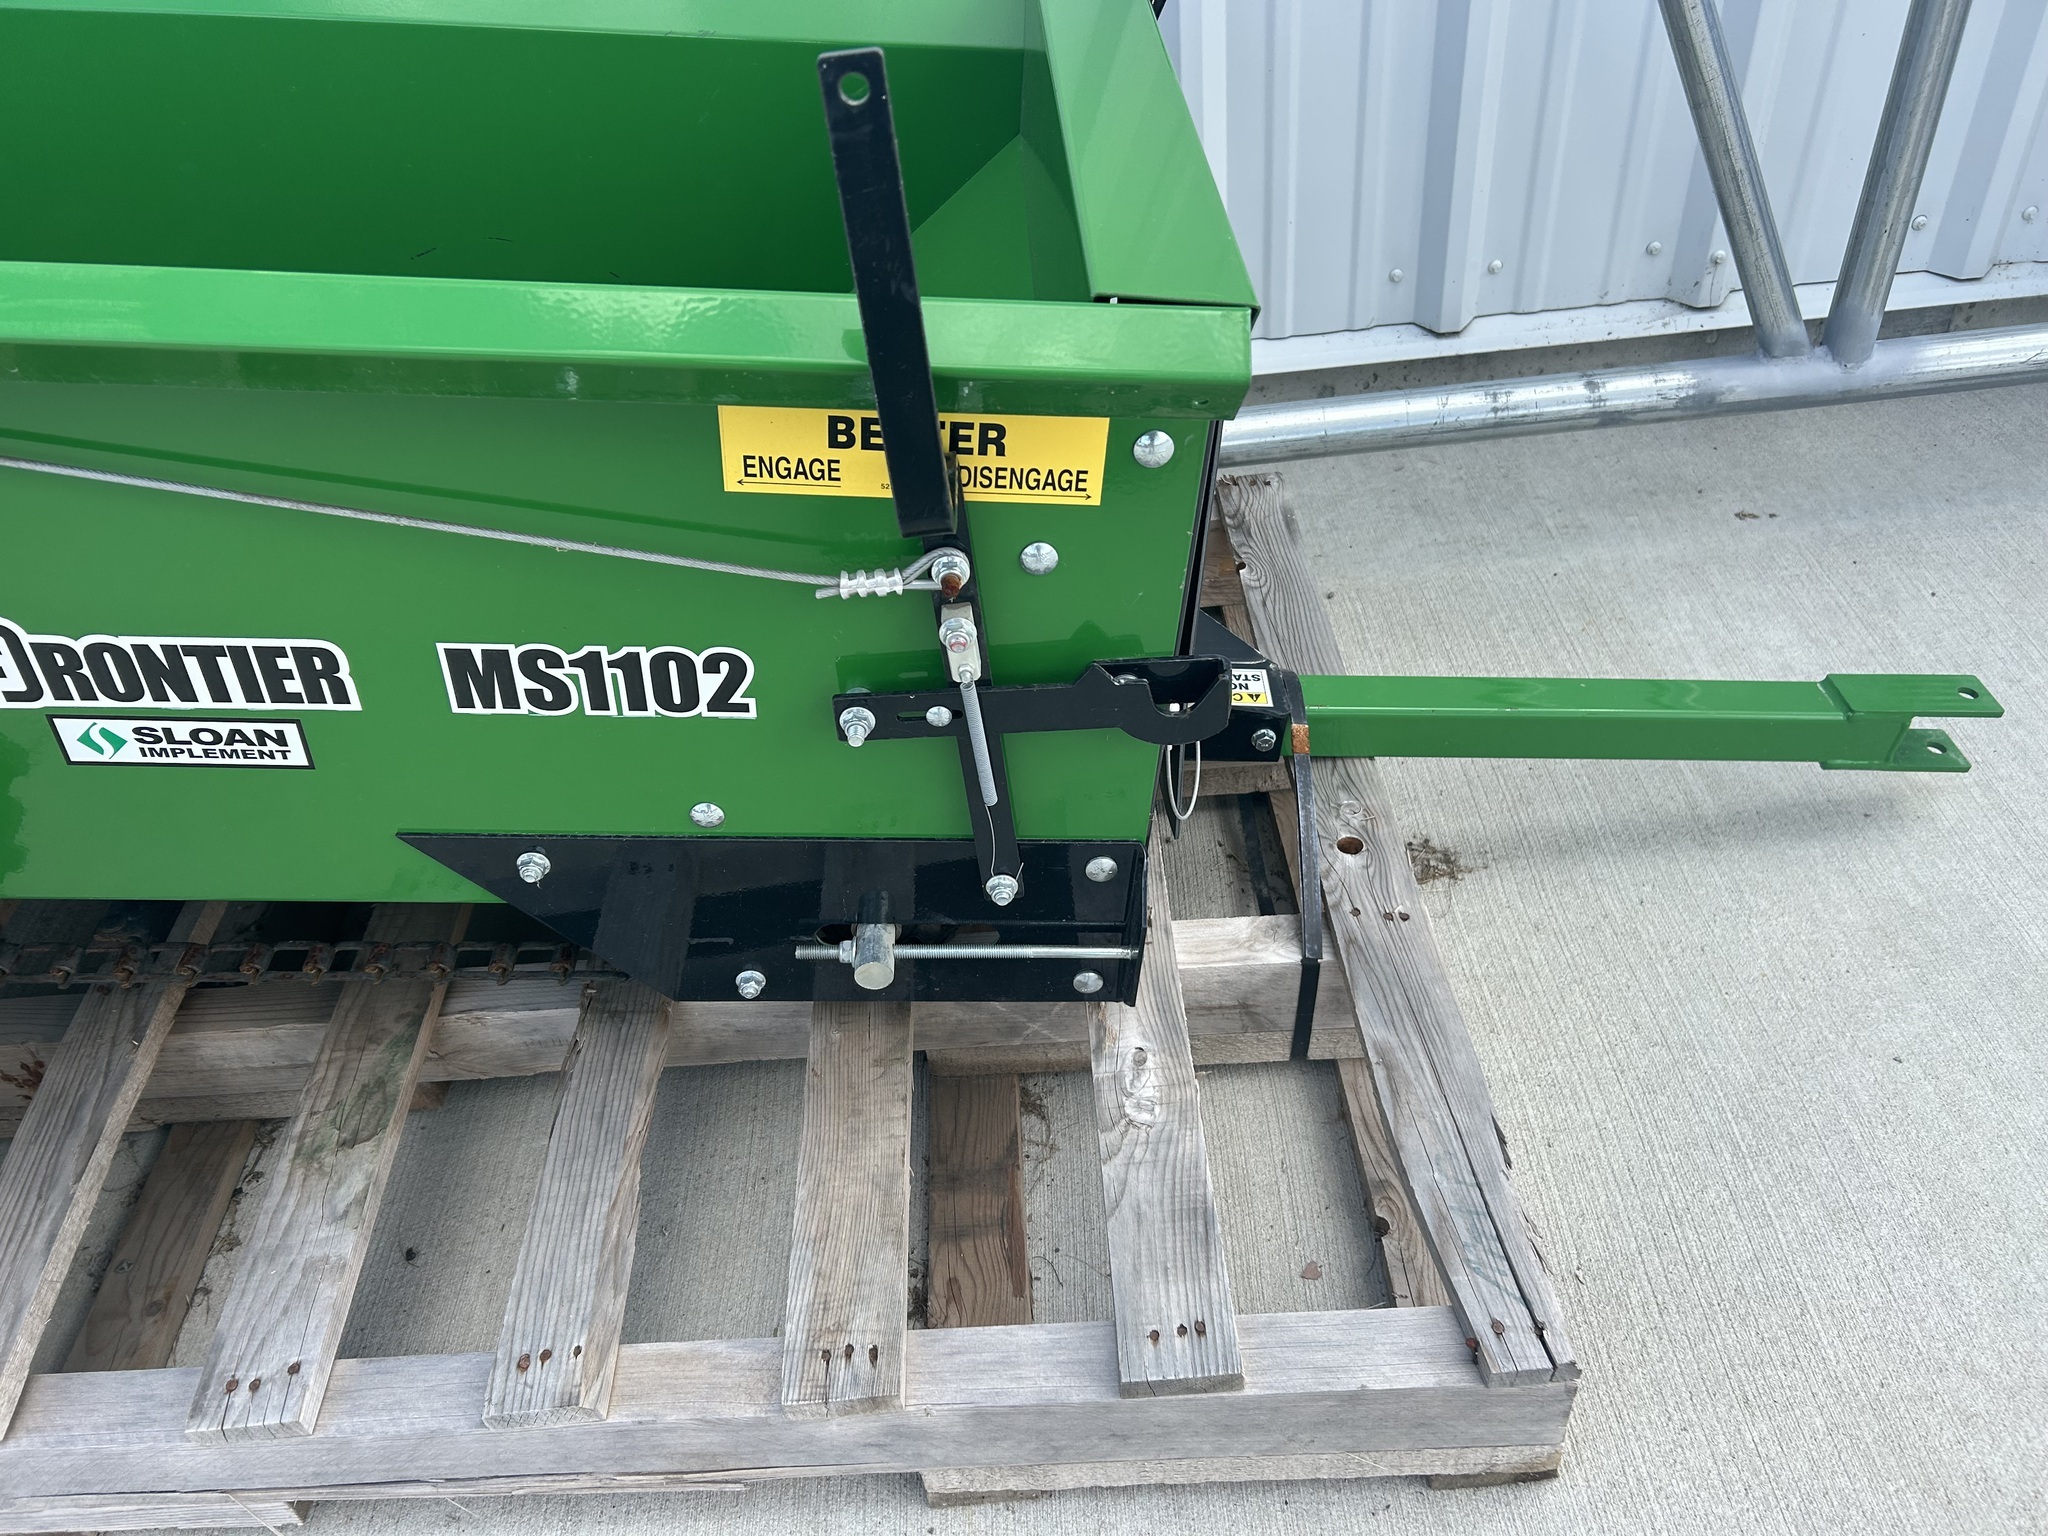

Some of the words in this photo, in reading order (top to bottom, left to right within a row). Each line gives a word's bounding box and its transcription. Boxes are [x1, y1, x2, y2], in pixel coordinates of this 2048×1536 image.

[827, 415, 1006, 457] BEER
[743, 455, 841, 482] ENGAGE
[960, 465, 1088, 492] DISENGAGE
[0, 624, 351, 704] RONTIER
[443, 648, 750, 712] MS1102
[131, 727, 289, 747] SLOAN
[139, 748, 291, 760] IMPLEMENT
